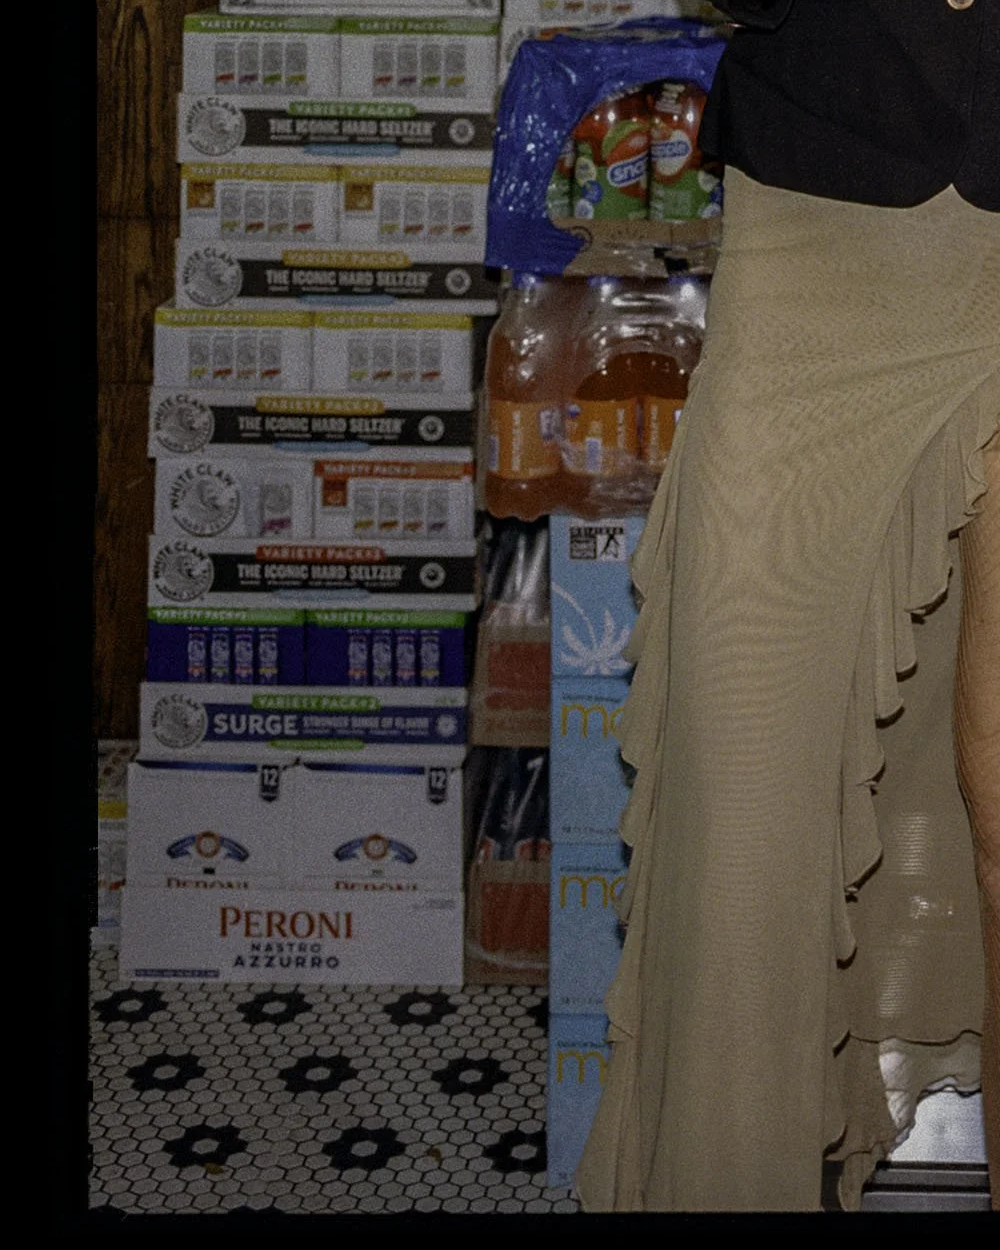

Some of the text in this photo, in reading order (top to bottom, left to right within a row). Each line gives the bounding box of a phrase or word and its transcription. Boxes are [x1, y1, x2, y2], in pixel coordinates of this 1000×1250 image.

[268, 118, 293, 134] THE
[265, 269, 432, 288] THE ICONIC HARD SELTZER
[237, 415, 406, 434] THE ICONIC HARD SELTZER
[262, 547, 323, 561] VARIETY
[237, 563, 262, 580] THE
[264, 563, 308, 581] ICONIC
[310, 564, 348, 581] HARD
[257, 695, 319, 709] VARIETY
[212, 713, 299, 736] SURGE
[262, 769, 279, 786] 12
[429, 770, 447, 788] 12
[219, 905, 354, 940] PERONI
[251, 942, 322, 955] NASTRO
[233, 955, 341, 969] AZZURRO
